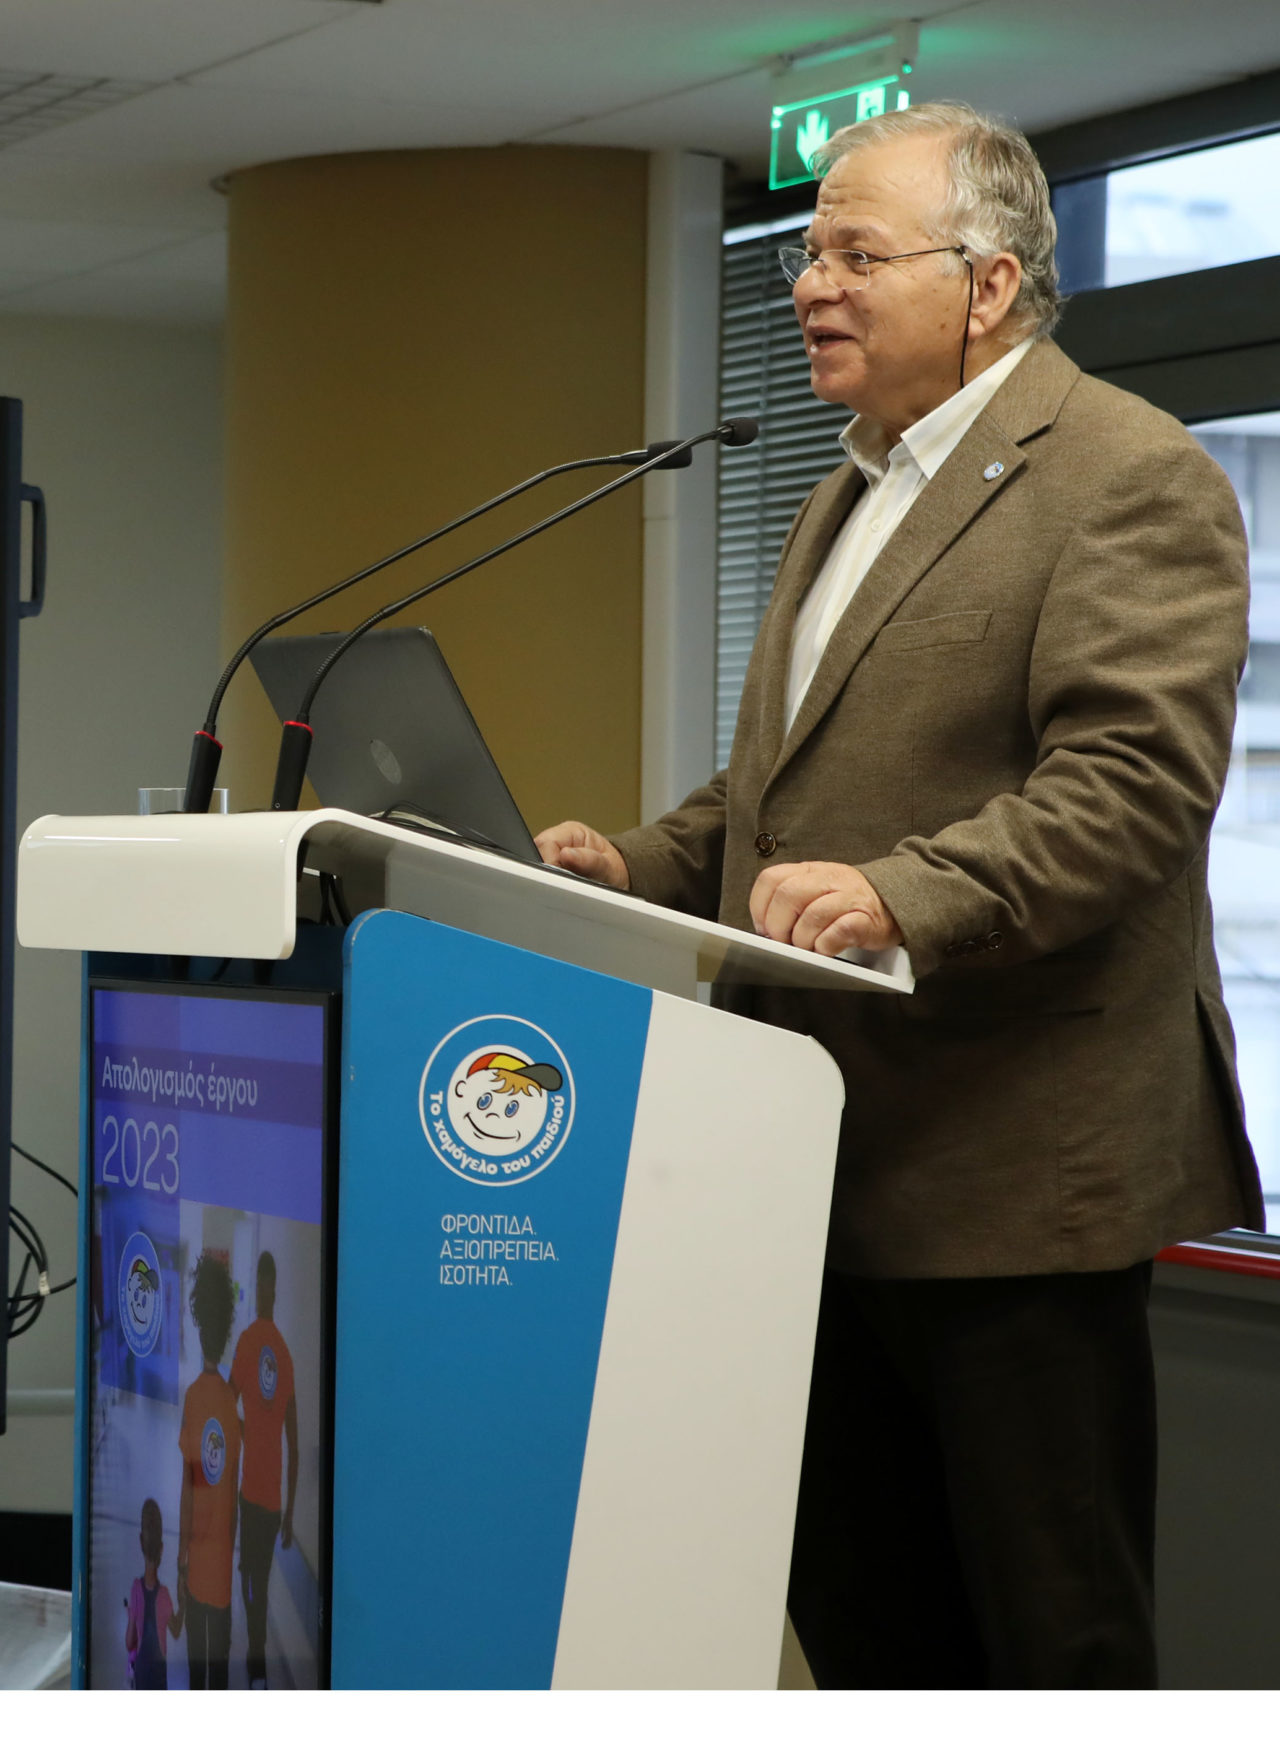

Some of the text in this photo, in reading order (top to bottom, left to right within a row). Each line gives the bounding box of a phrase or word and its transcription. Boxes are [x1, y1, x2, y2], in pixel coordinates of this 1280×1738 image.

[102, 1056, 258, 1112] Απολογισμός έργου
[430, 1091, 565, 1175] Το χαμόγελο του παιδιού
[102, 1115, 180, 1194] 2023
[441, 1214, 537, 1235] ΦΡΟΝΤΙΔΑ.
[440, 1240, 559, 1261] ΑΞΙΟΠΡΕΠΕΙΑ.
[440, 1265, 512, 1286] ΙΣΟΤΗΤΑ.
